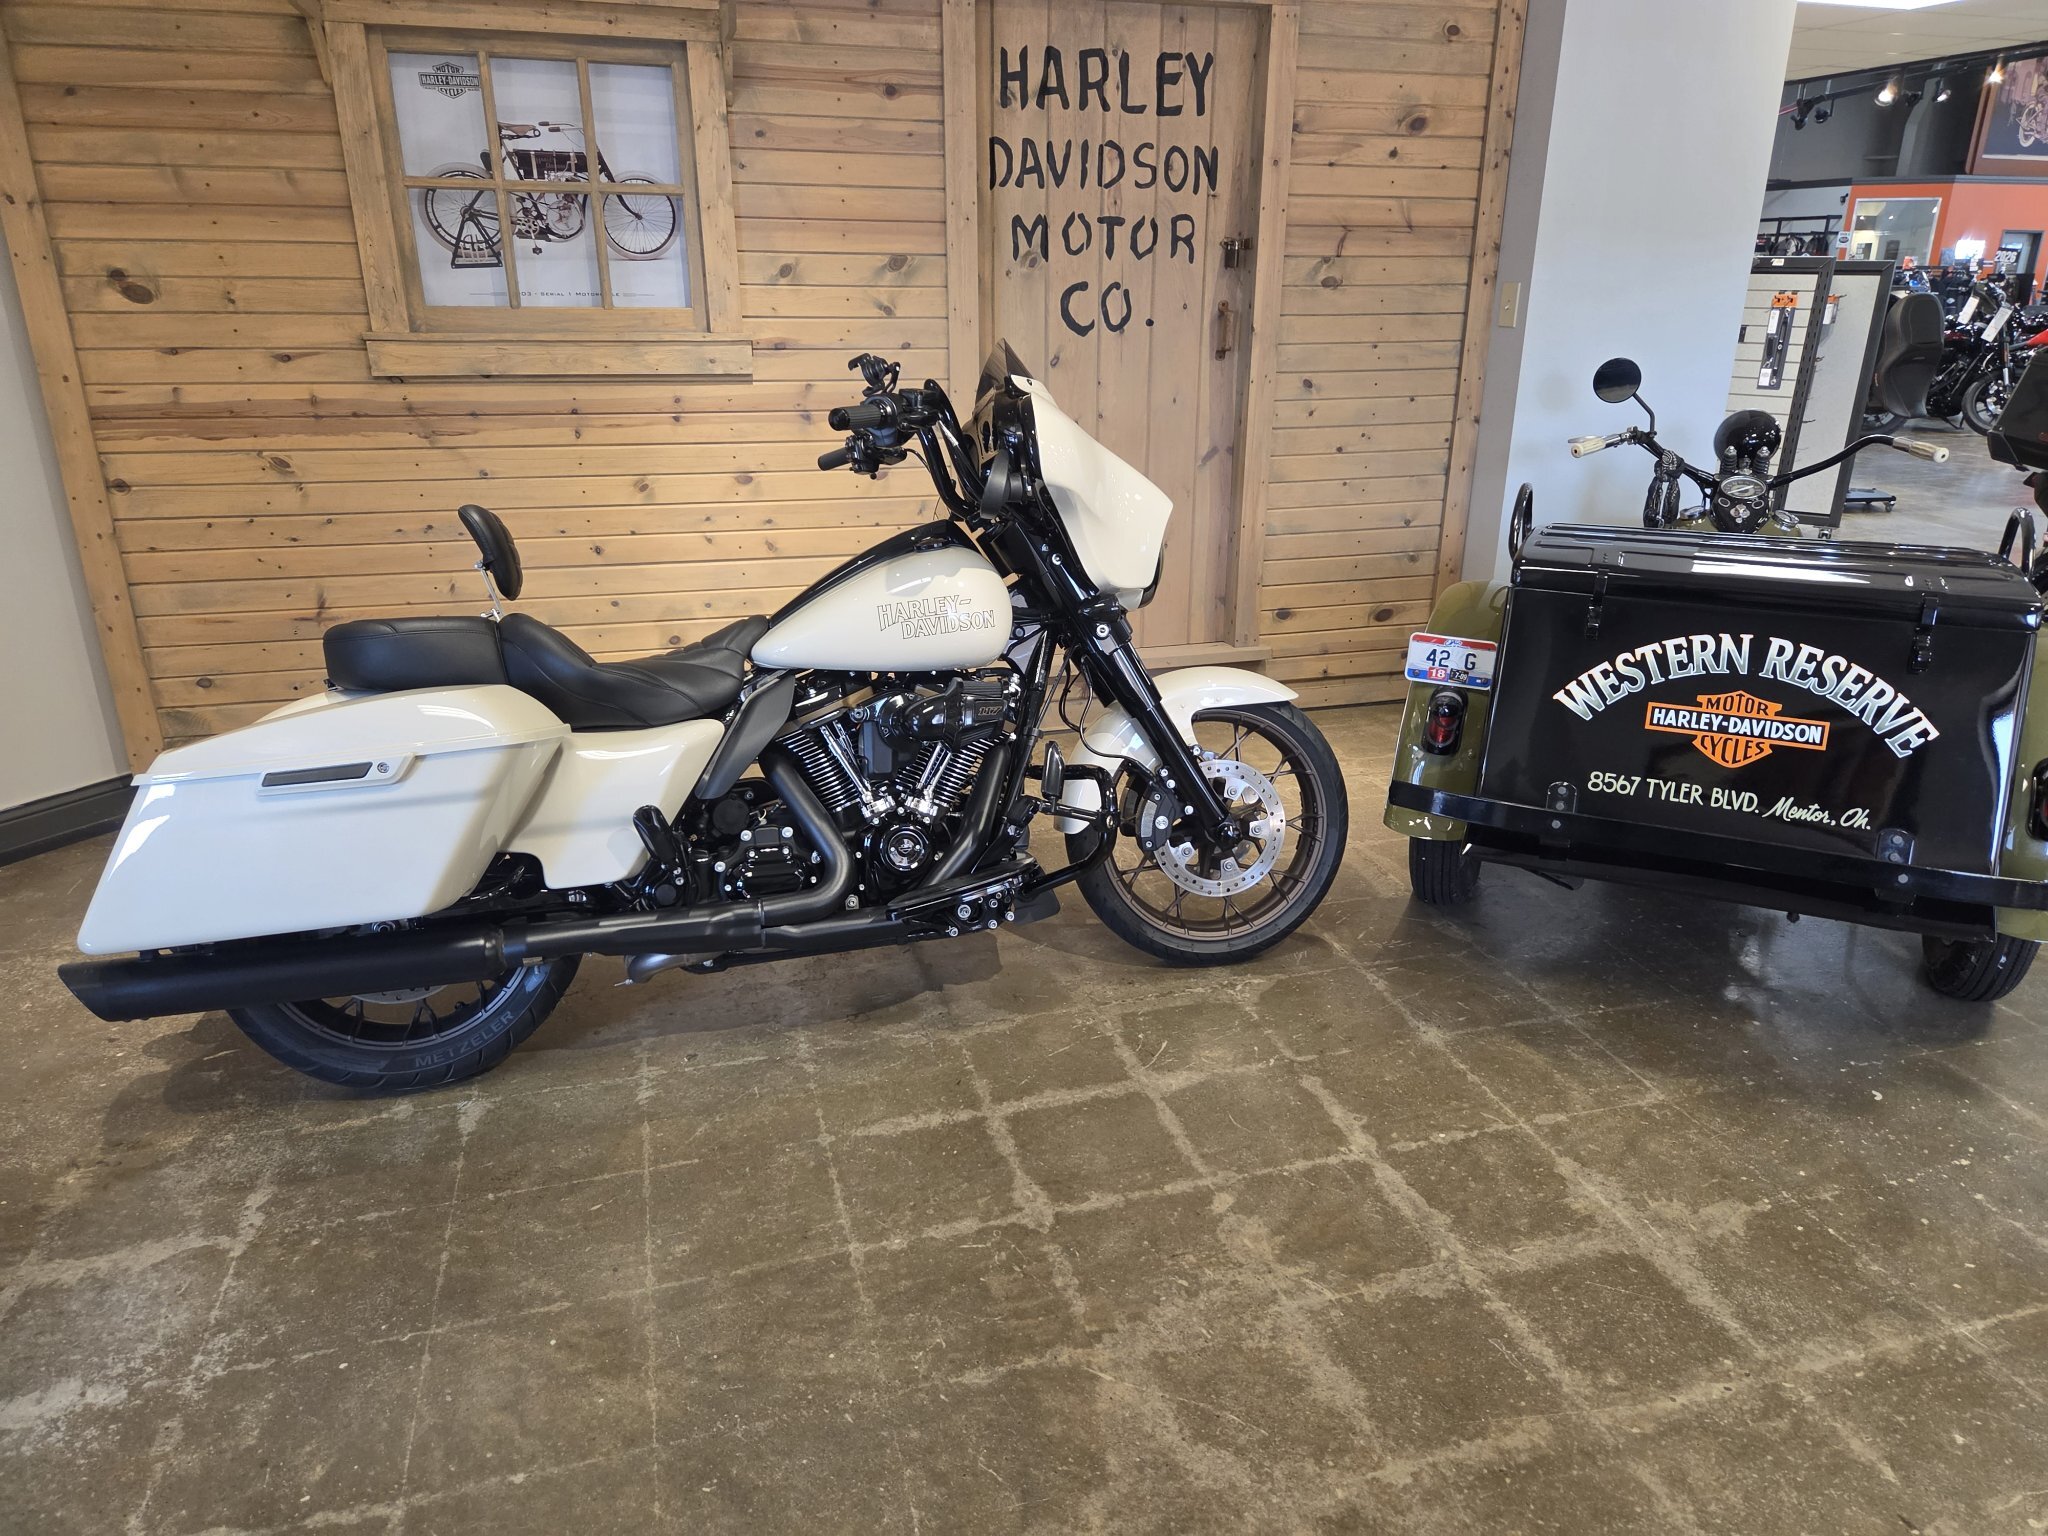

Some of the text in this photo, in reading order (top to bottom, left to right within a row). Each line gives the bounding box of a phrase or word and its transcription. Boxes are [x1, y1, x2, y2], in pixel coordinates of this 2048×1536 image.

[421, 74, 480, 86] HARLEY-DAVIDSON
[436, 64, 460, 74] MOTOR
[999, 45, 1214, 116] HARLEY
[440, 87, 464, 97] CYCLES
[989, 136, 1219, 195] DAVIDSON
[1011, 211, 1195, 264] MOTOR
[1060, 281, 1154, 337] CO.
[877, 595, 971, 632] HARLEY-
[900, 609, 996, 640] DAVIDSON
[1426, 648, 1477, 670] 42 G
[1430, 669, 1446, 678] 18
[1552, 633, 1940, 759] WESTERN RESERVE
[1706, 693, 1769, 716] MOTOR
[1653, 708, 1823, 744] HARLEY-DAVIDSON
[1700, 734, 1766, 765] CYCLES
[1587, 771, 1872, 831] 8567 TYLER BLVD. Mentor, Oh.
